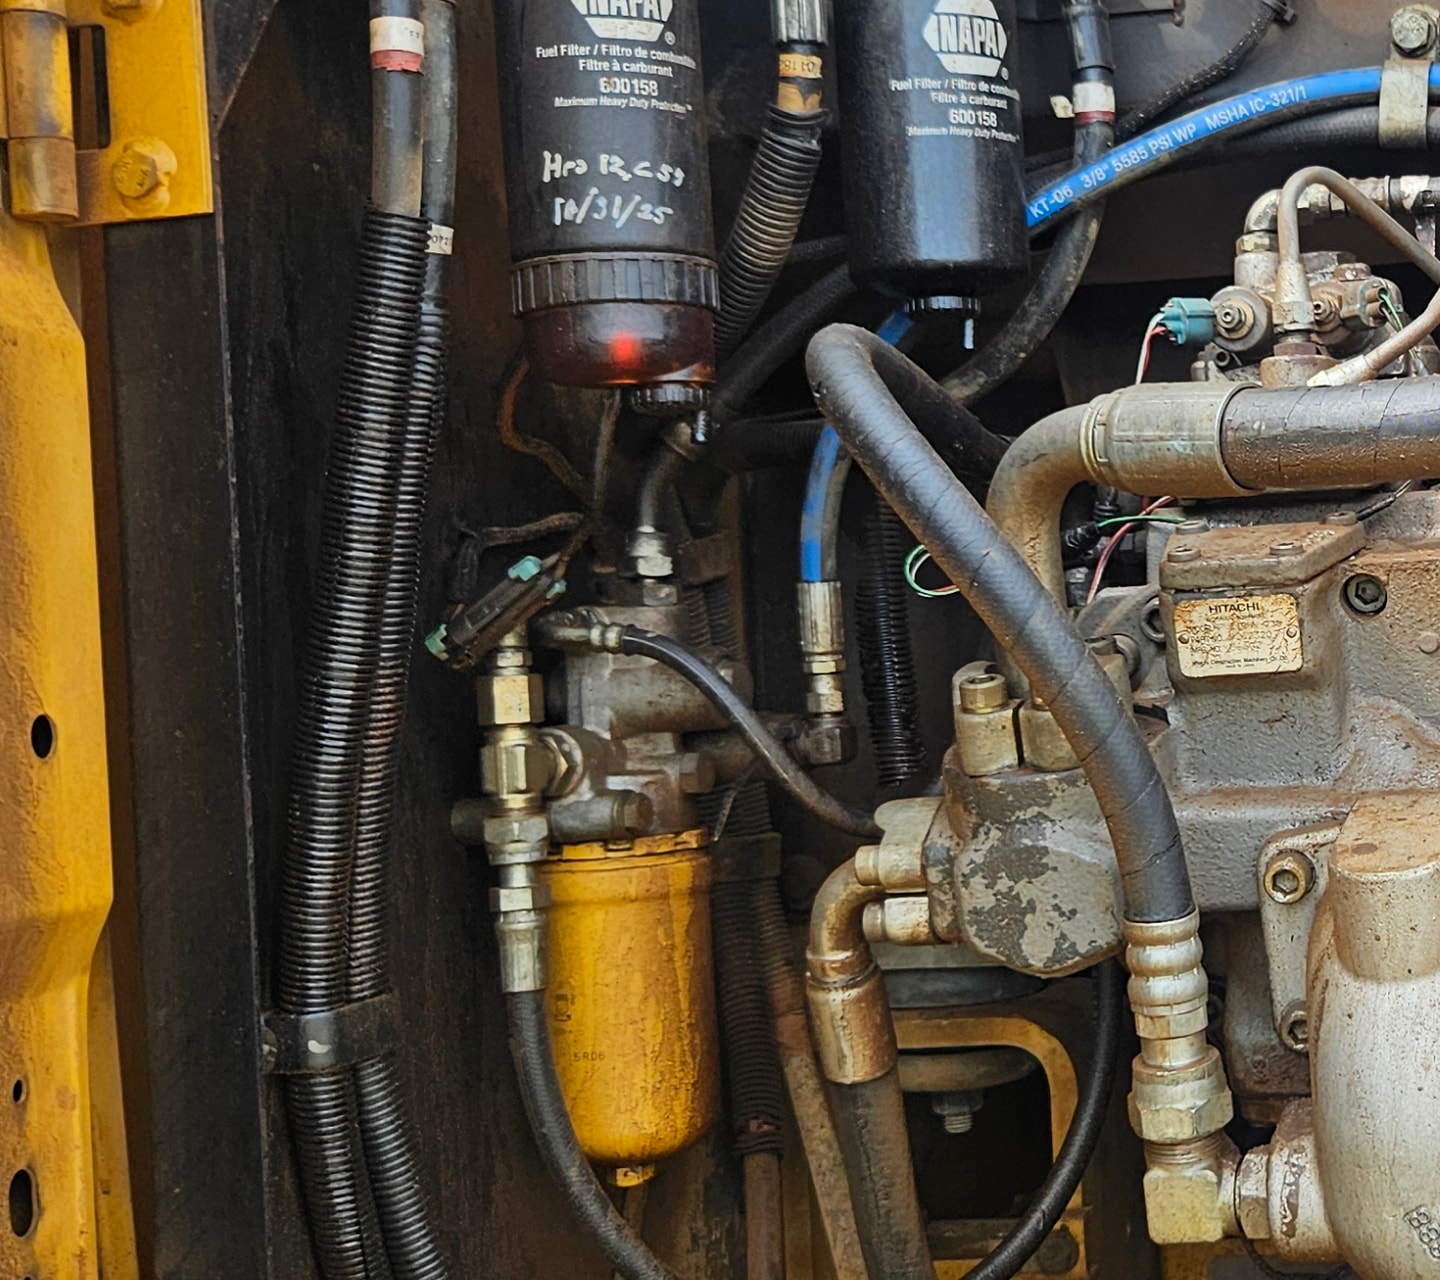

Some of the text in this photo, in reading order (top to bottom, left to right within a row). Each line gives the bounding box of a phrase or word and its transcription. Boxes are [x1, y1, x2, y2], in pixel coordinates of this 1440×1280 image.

[938, 13, 999, 57] NAPA
[536, 45, 558, 59] Fuel
[560, 44, 590, 57] Filter
[593, 44, 599, 56] /
[601, 44, 632, 59] Filtro
[634, 46, 648, 59] de
[578, 58, 674, 78] Filtre à carburant
[599, 77, 659, 97] 600158
[890, 78, 912, 91] Fuel
[914, 78, 942, 90] Filter
[951, 78, 977, 91] Filtro
[978, 81, 990, 93] de
[554, 96, 598, 108] Maximum
[599, 95, 628, 109] Heavy
[628, 97, 649, 110] Duty
[930, 92, 958, 104] Filtre
[968, 94, 1008, 110] carburant
[949, 108, 998, 127] 600158
[1028, 84, 1308, 219] KT-06 3/8" 5585 PSI WP MSHA IC-321/1
[1208, 601, 1261, 614] HITACHI
